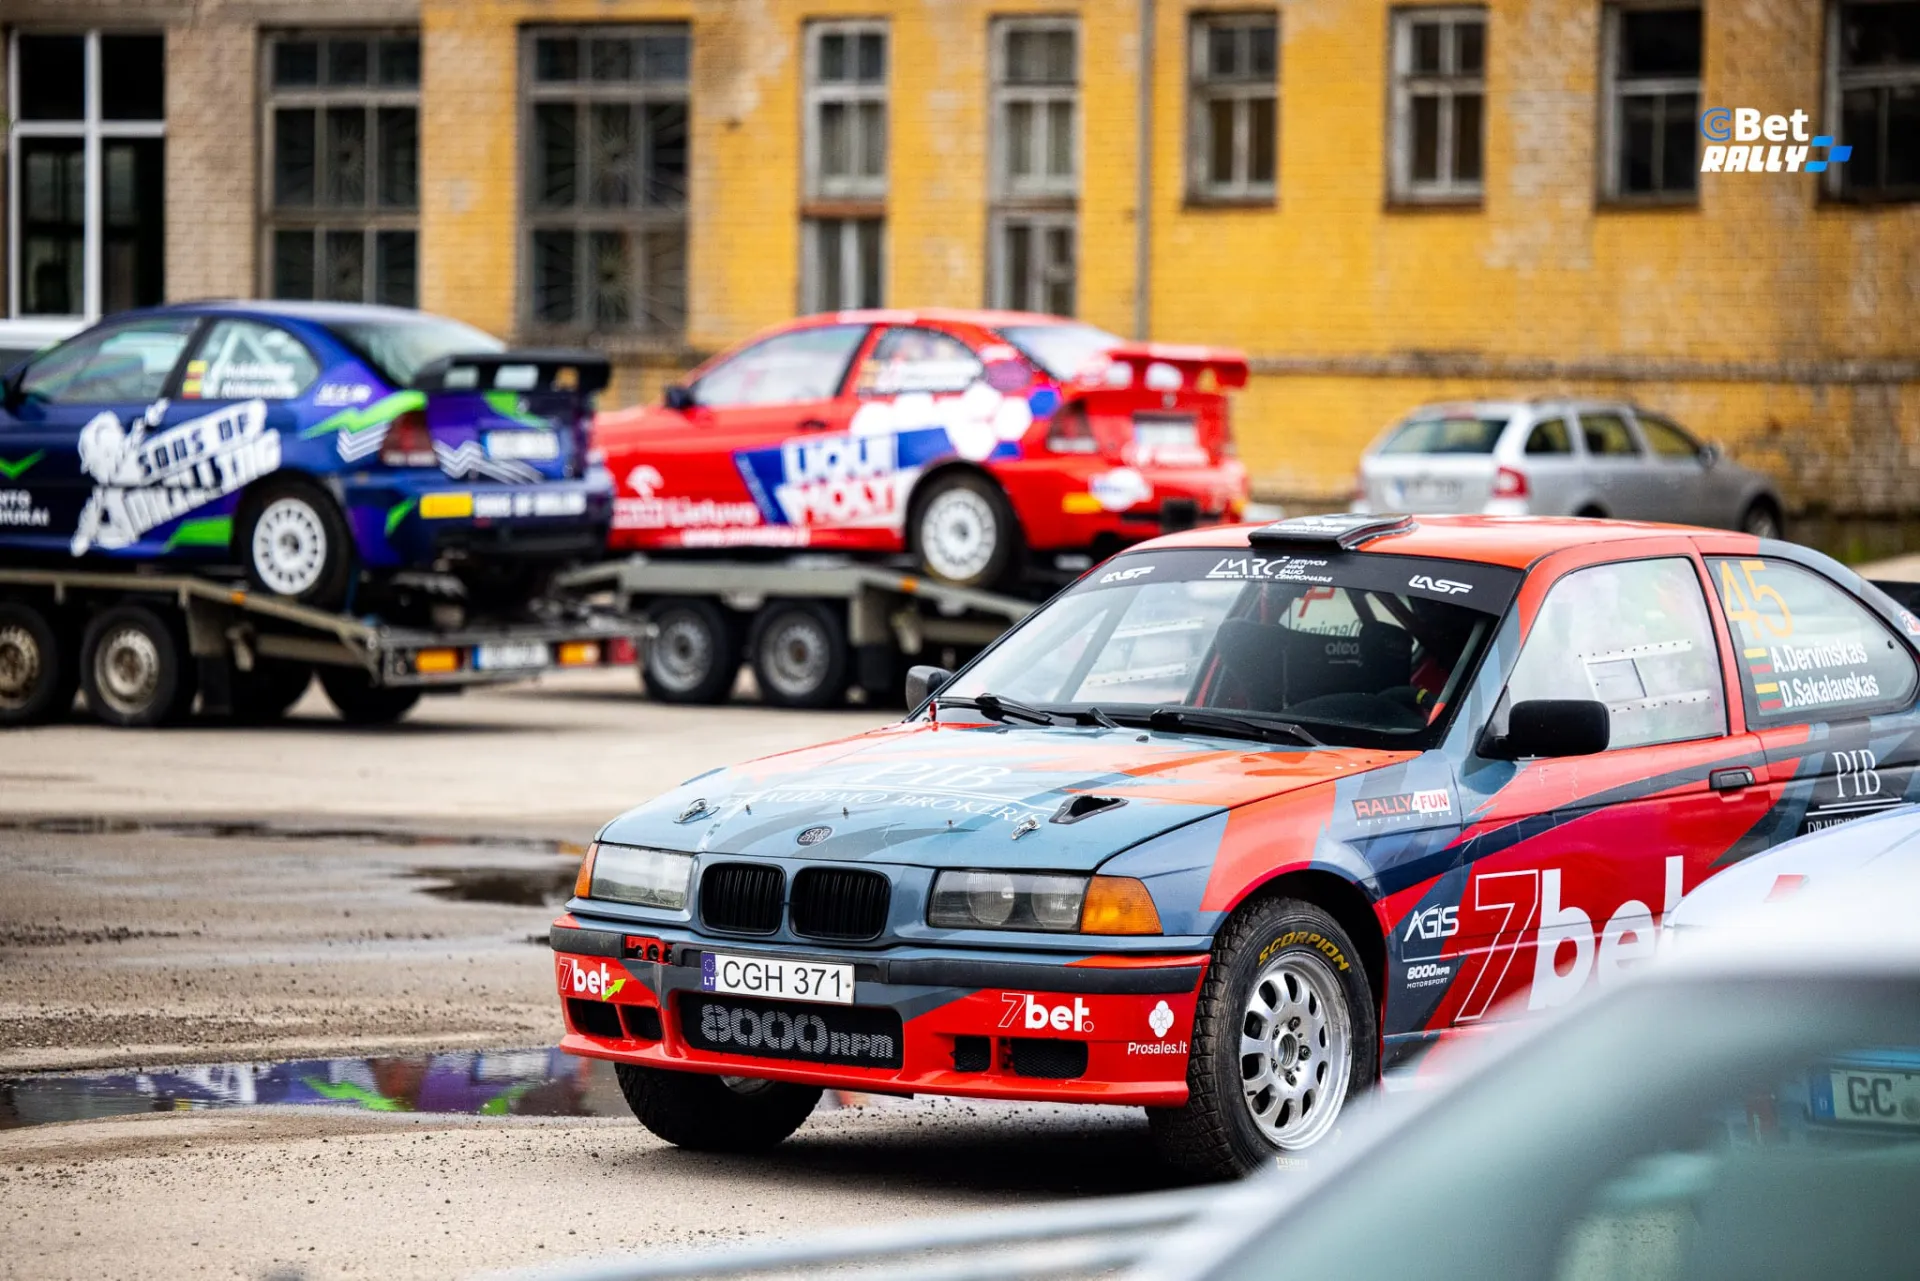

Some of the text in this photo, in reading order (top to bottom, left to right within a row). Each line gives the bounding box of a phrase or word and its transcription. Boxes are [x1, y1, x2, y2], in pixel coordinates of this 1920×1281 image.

[1408, 574, 1474, 595] LASF
[1720, 560, 1793, 641] 45
[1770, 639, 1868, 674] A.Dervinskas
[1779, 671, 1880, 708] D.Sakalauskas
[848, 762, 1013, 788] PIB
[1832, 748, 1881, 798] PIB
[1403, 903, 1460, 943] AGIS
[1257, 931, 1350, 971] SCORPION
[704, 960, 841, 998] LT CGH 371
[1406, 977, 1449, 990] MOTORSPORT
[1127, 1040, 1188, 1056] Prosales.lt
[1847, 1076, 1897, 1117] GC
